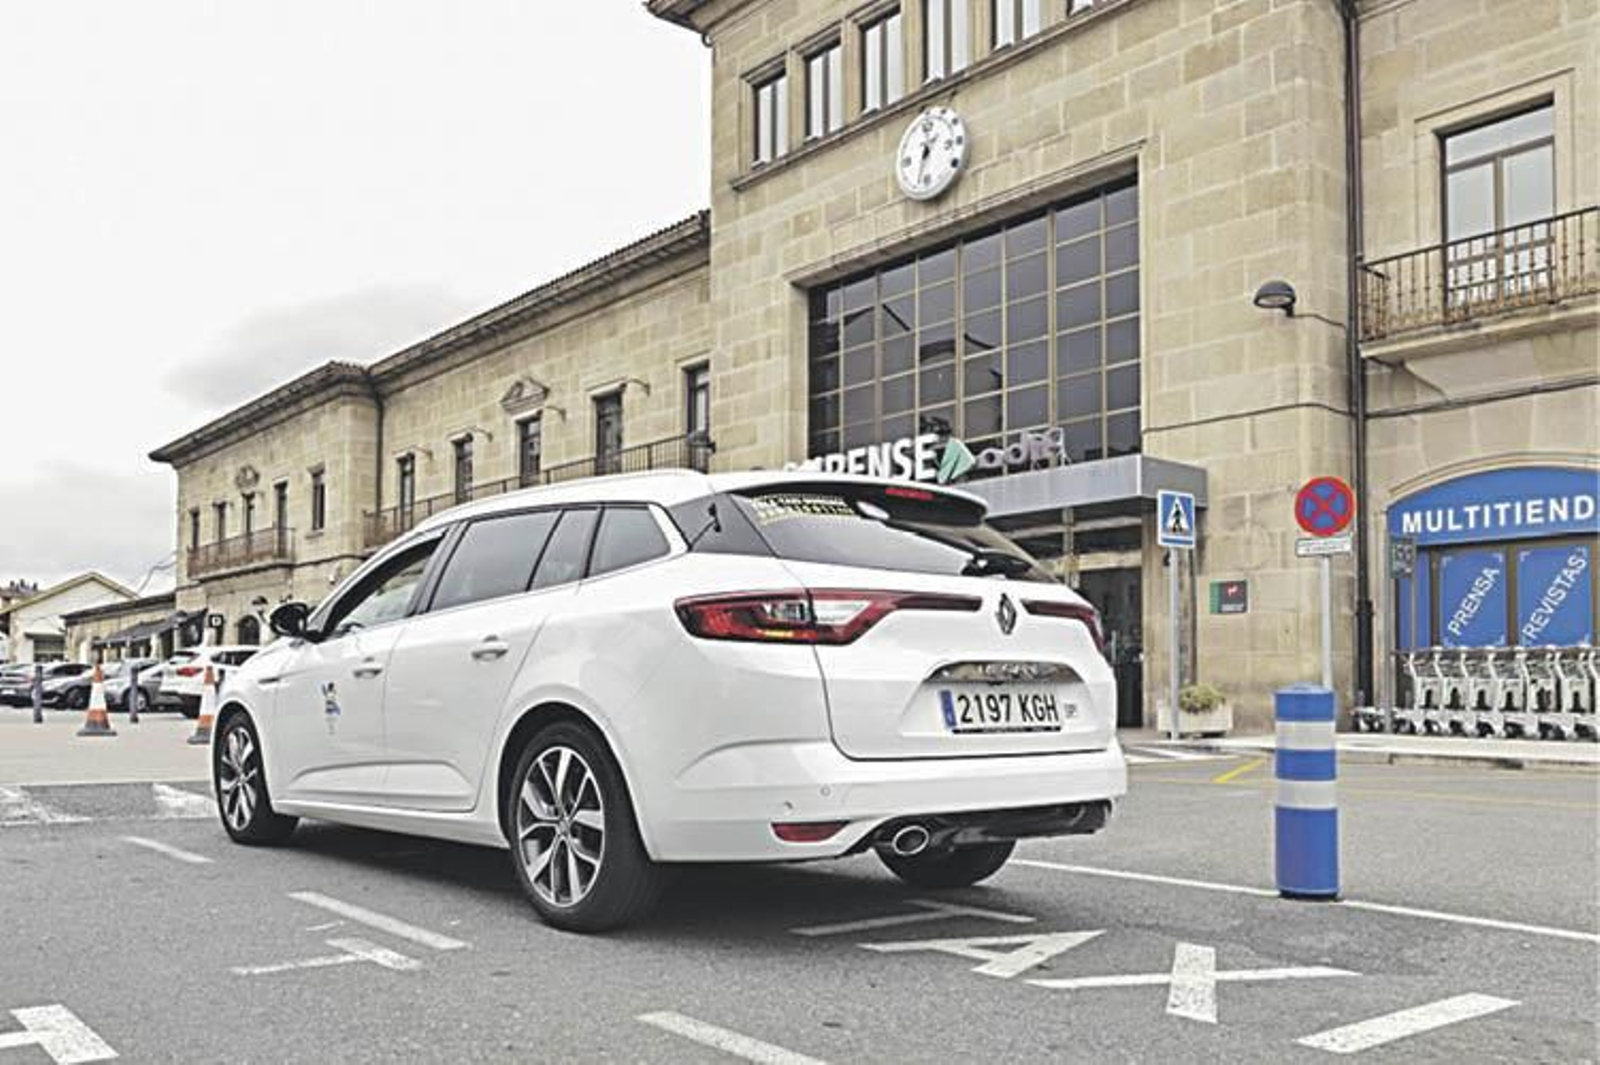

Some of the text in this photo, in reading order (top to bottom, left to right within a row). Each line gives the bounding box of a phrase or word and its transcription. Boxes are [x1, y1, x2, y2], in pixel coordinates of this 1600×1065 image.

[784, 433, 939, 480] RENSE
[1447, 566, 1500, 636] PRENSA
[1522, 552, 1588, 640] REVISTAS
[958, 693, 1059, 723] 2197 KGH
